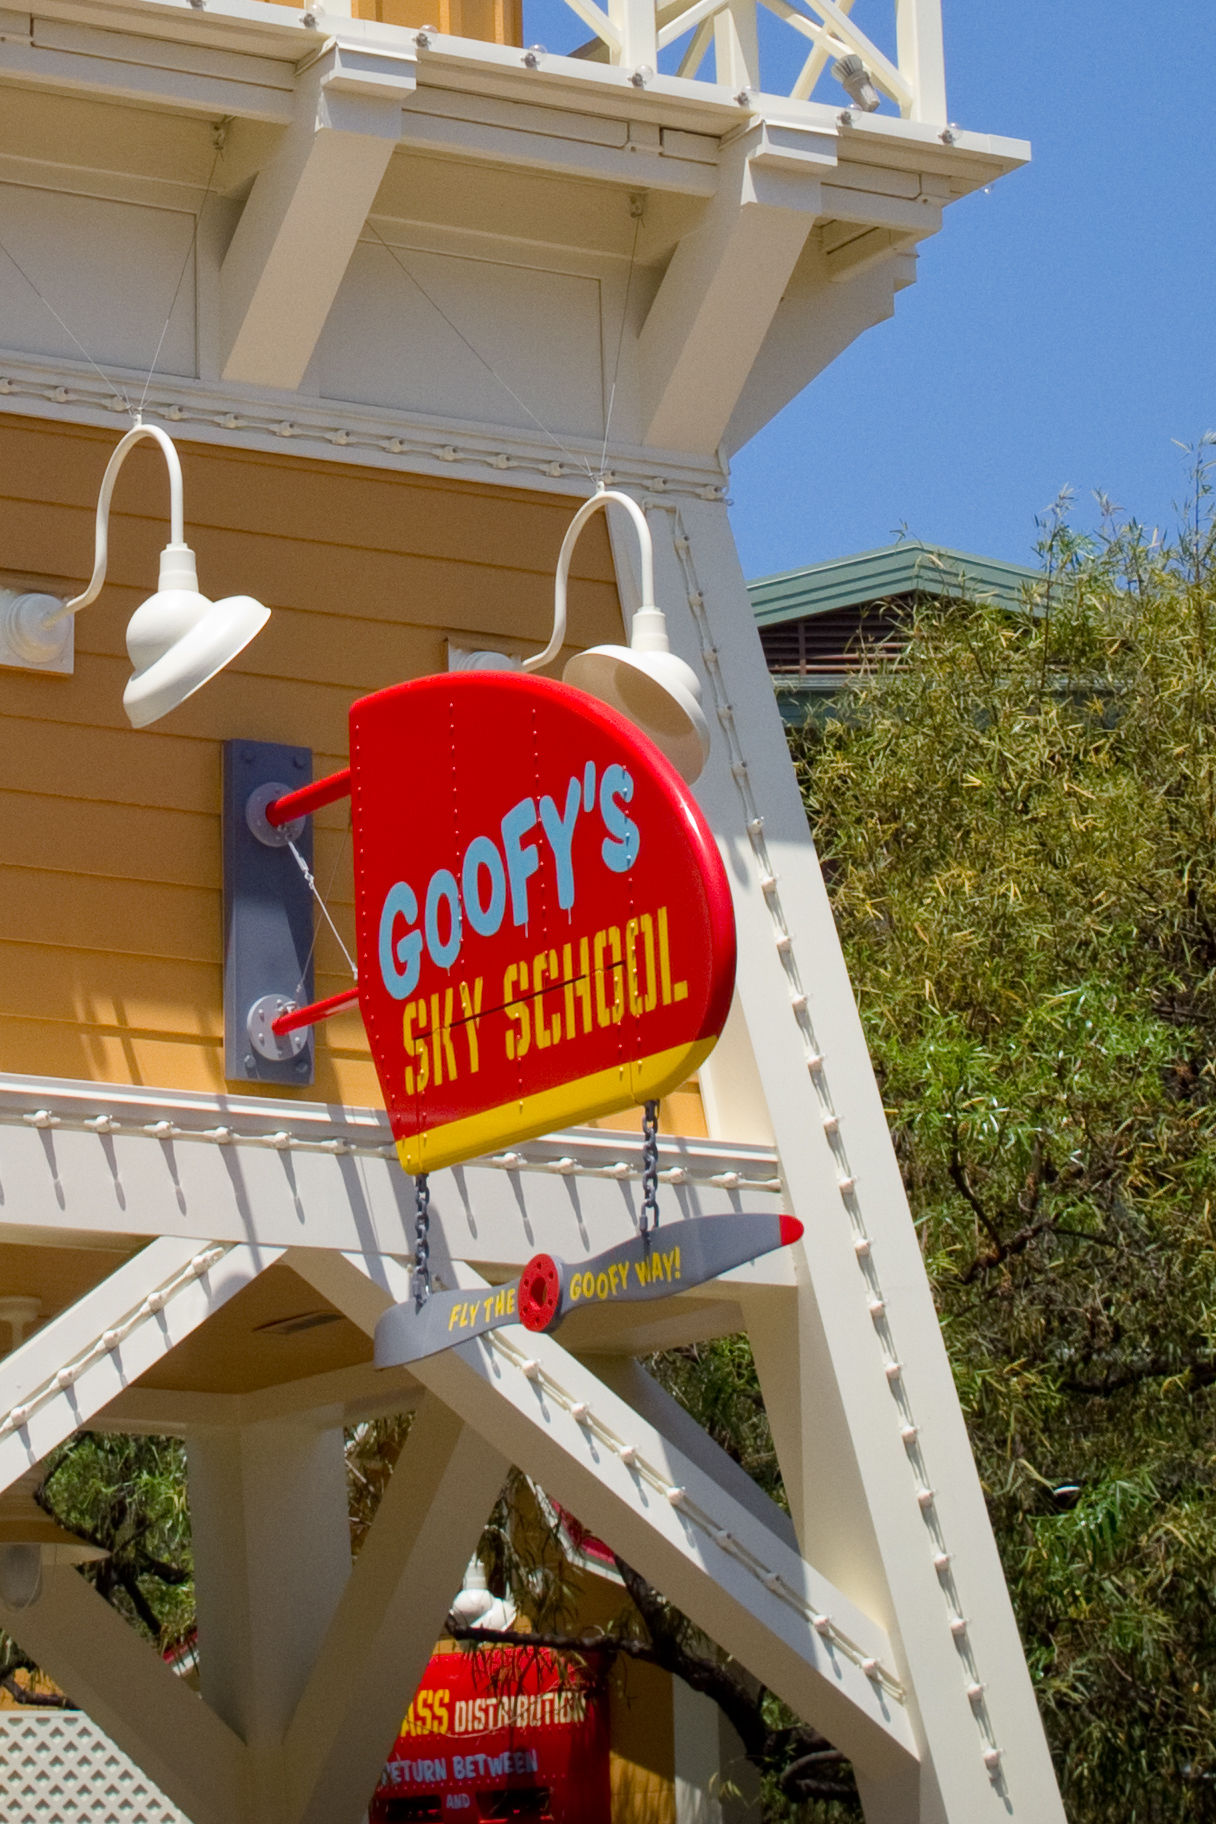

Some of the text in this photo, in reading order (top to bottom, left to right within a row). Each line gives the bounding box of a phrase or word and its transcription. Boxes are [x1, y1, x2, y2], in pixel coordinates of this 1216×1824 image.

[378, 760, 640, 1000] GOOFY'S
[403, 906, 688, 1096] SKY SCHOOL
[448, 1246, 681, 1331] FLY THE GOOFY WAY!
[446, 1794, 470, 1809] AND
[452, 1749, 538, 1779] BETWEEN
